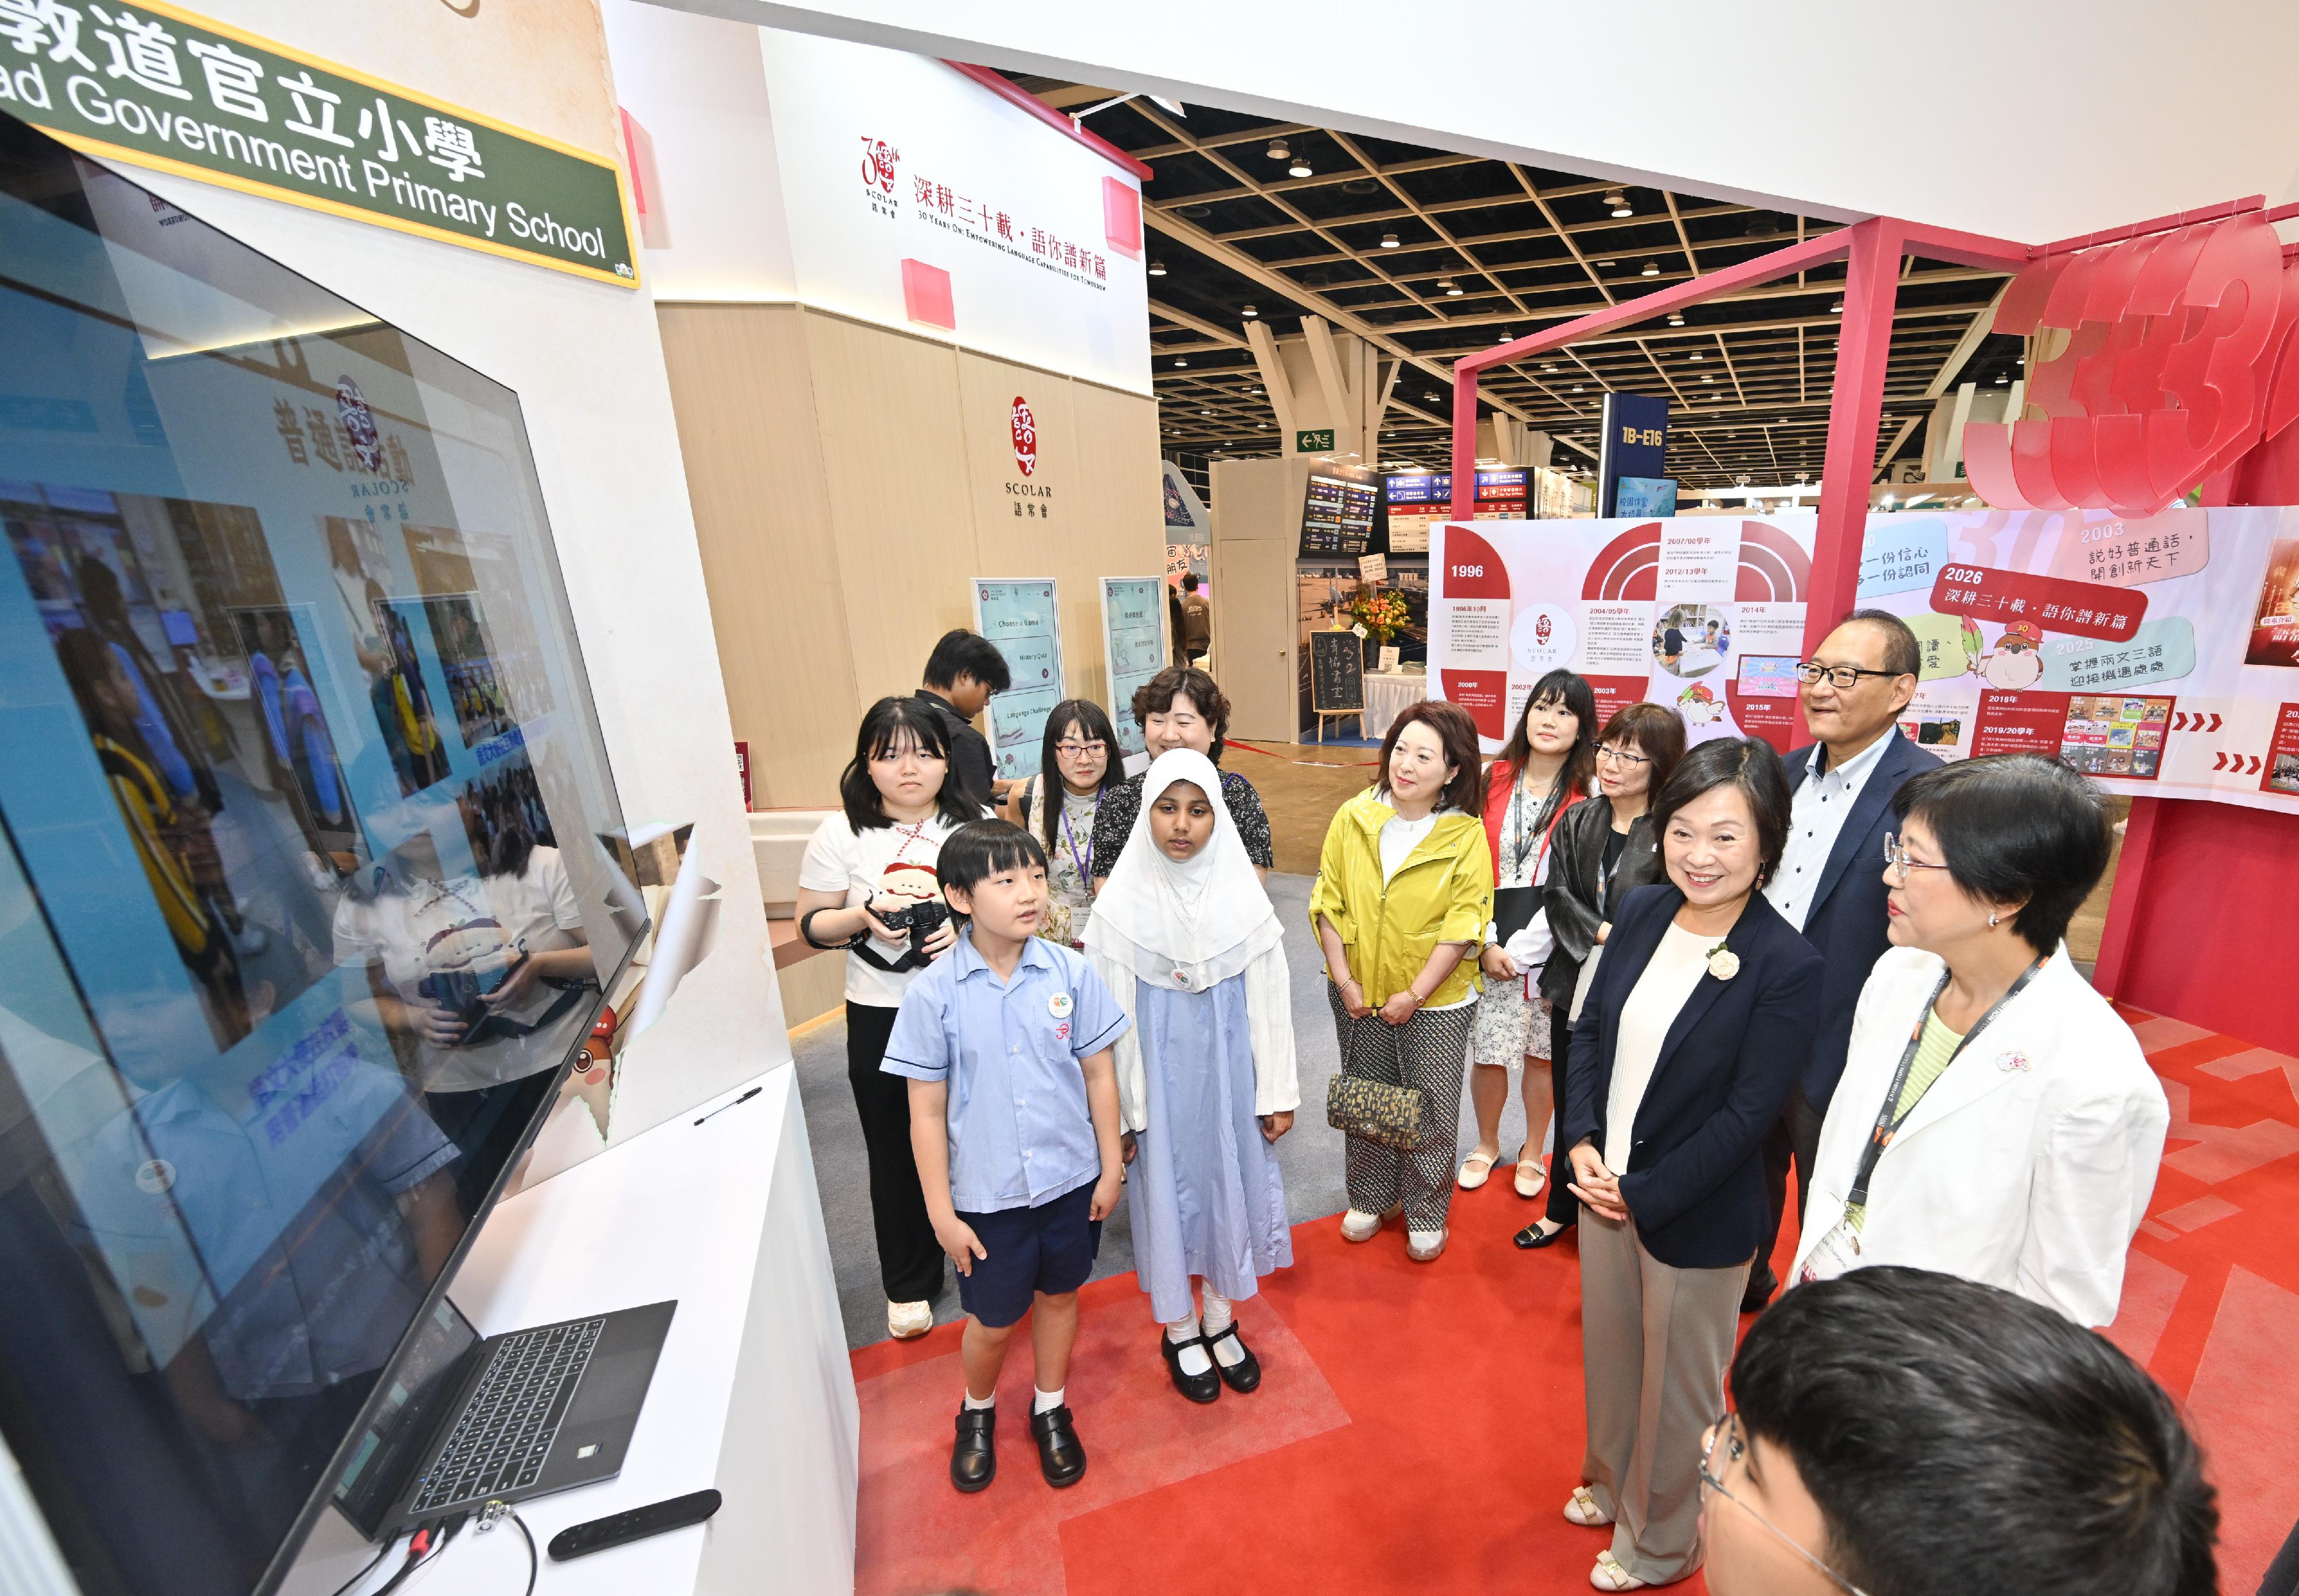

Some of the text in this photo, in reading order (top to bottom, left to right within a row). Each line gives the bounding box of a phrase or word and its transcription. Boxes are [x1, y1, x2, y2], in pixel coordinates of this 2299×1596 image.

[67, 75, 357, 192] Government
[363, 159, 496, 237] Primary
[506, 202, 606, 258] School
[866, 189, 898, 207] SCOLAR
[918, 210, 926, 220] 30
[1623, 426, 1662, 447] 1B-E16
[1006, 483, 1051, 497] SCOLAR
[1014, 501, 1047, 518] 語常會
[1620, 497, 1648, 507] 校園作家
[2080, 522, 2125, 543] 2003
[1167, 559, 1187, 575] 朋友
[1452, 566, 1483, 577] 1996
[2090, 552, 2179, 580] 開創新天下
[1945, 567, 1983, 584] 2026
[2017, 624, 2029, 633] 30
[2056, 639, 2094, 656] 2025
[2069, 645, 2163, 672] 掌握兩文三語
[1347, 663, 1356, 674] 2
[2071, 661, 2164, 686] 迎接機遇處處
[1007, 706, 1051, 718] Language Challenge
[1983, 726, 2035, 735] 2019/20學年
[1887, 1053, 1910, 1102] EXHIBITION PLUS
